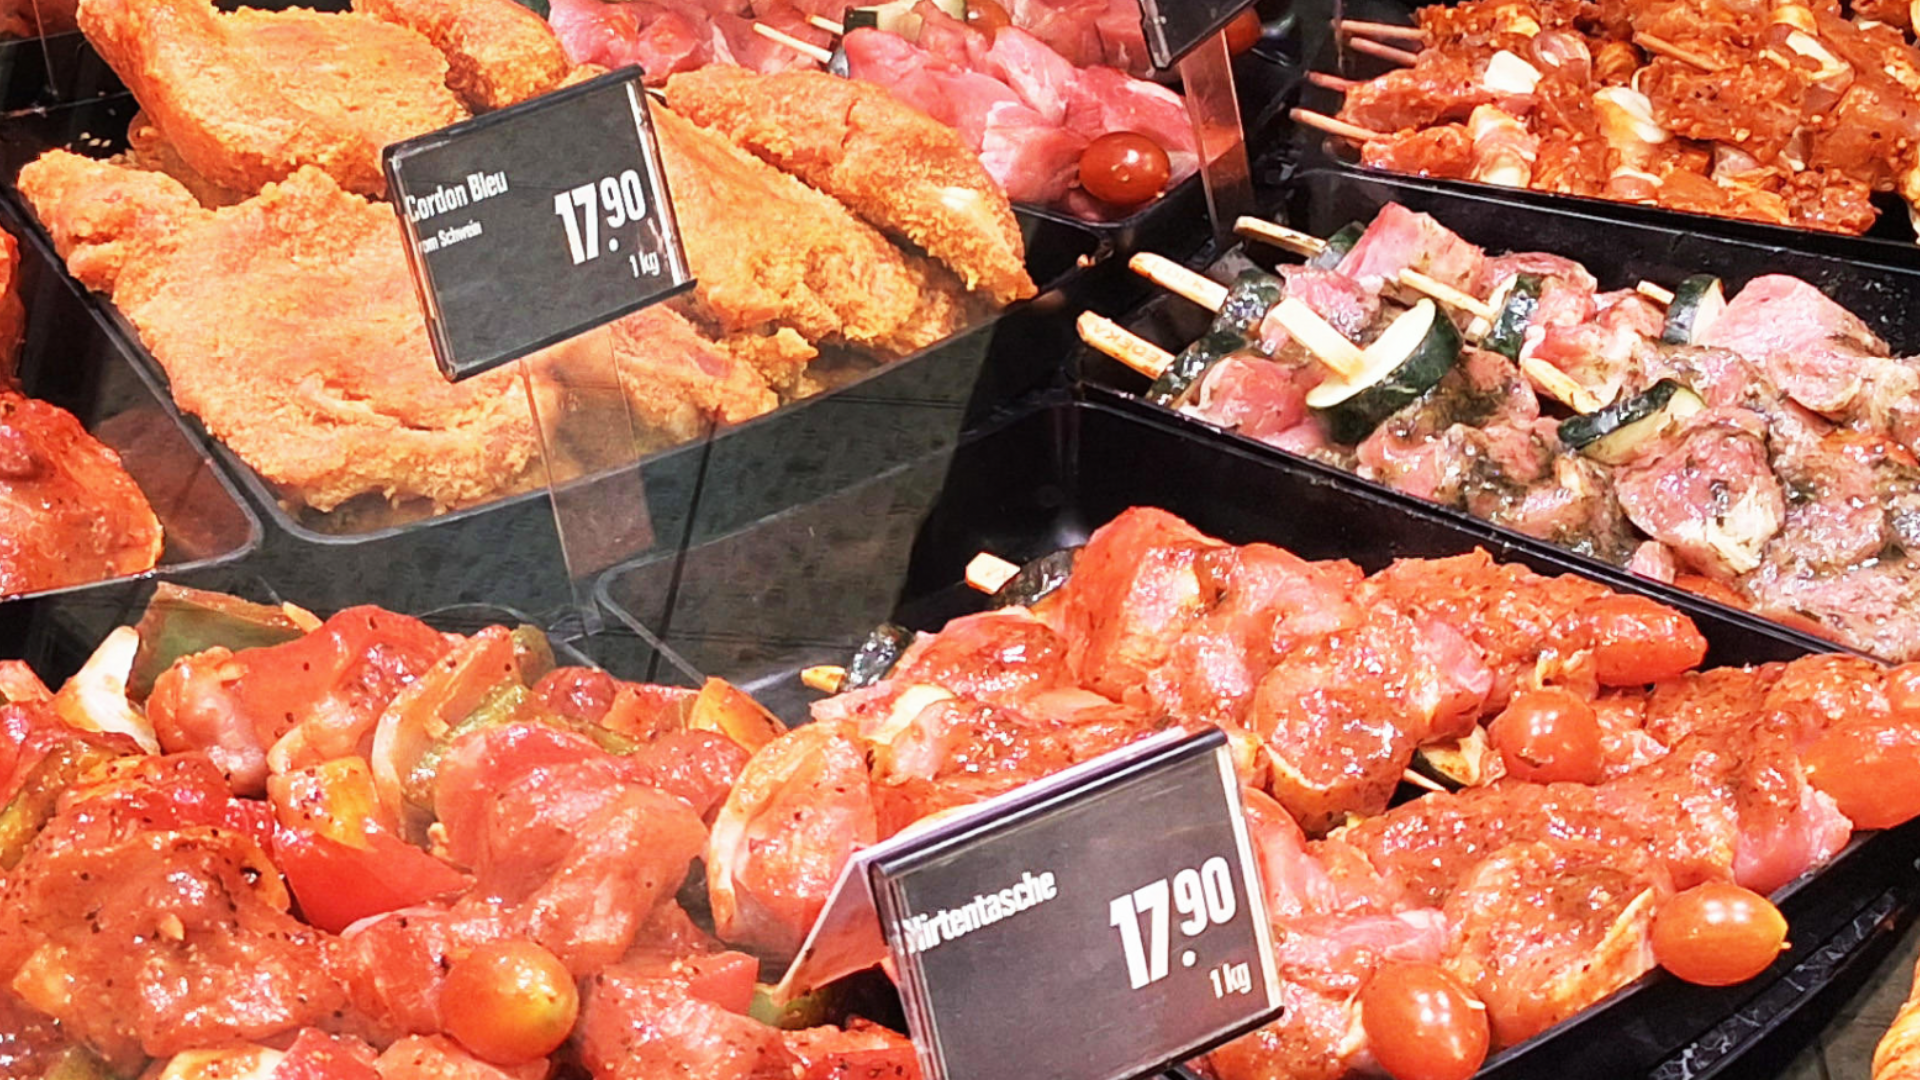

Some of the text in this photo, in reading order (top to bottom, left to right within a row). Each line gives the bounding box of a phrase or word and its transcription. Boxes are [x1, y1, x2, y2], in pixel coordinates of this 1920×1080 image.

[405, 171, 508, 223] Cordon Bleu
[554, 169, 646, 265] 17.90
[438, 219, 483, 248] Schwein
[629, 250, 660, 278] 1 kg
[1109, 856, 1237, 990] 17.90
[1210, 963, 1252, 999] 1 kg
